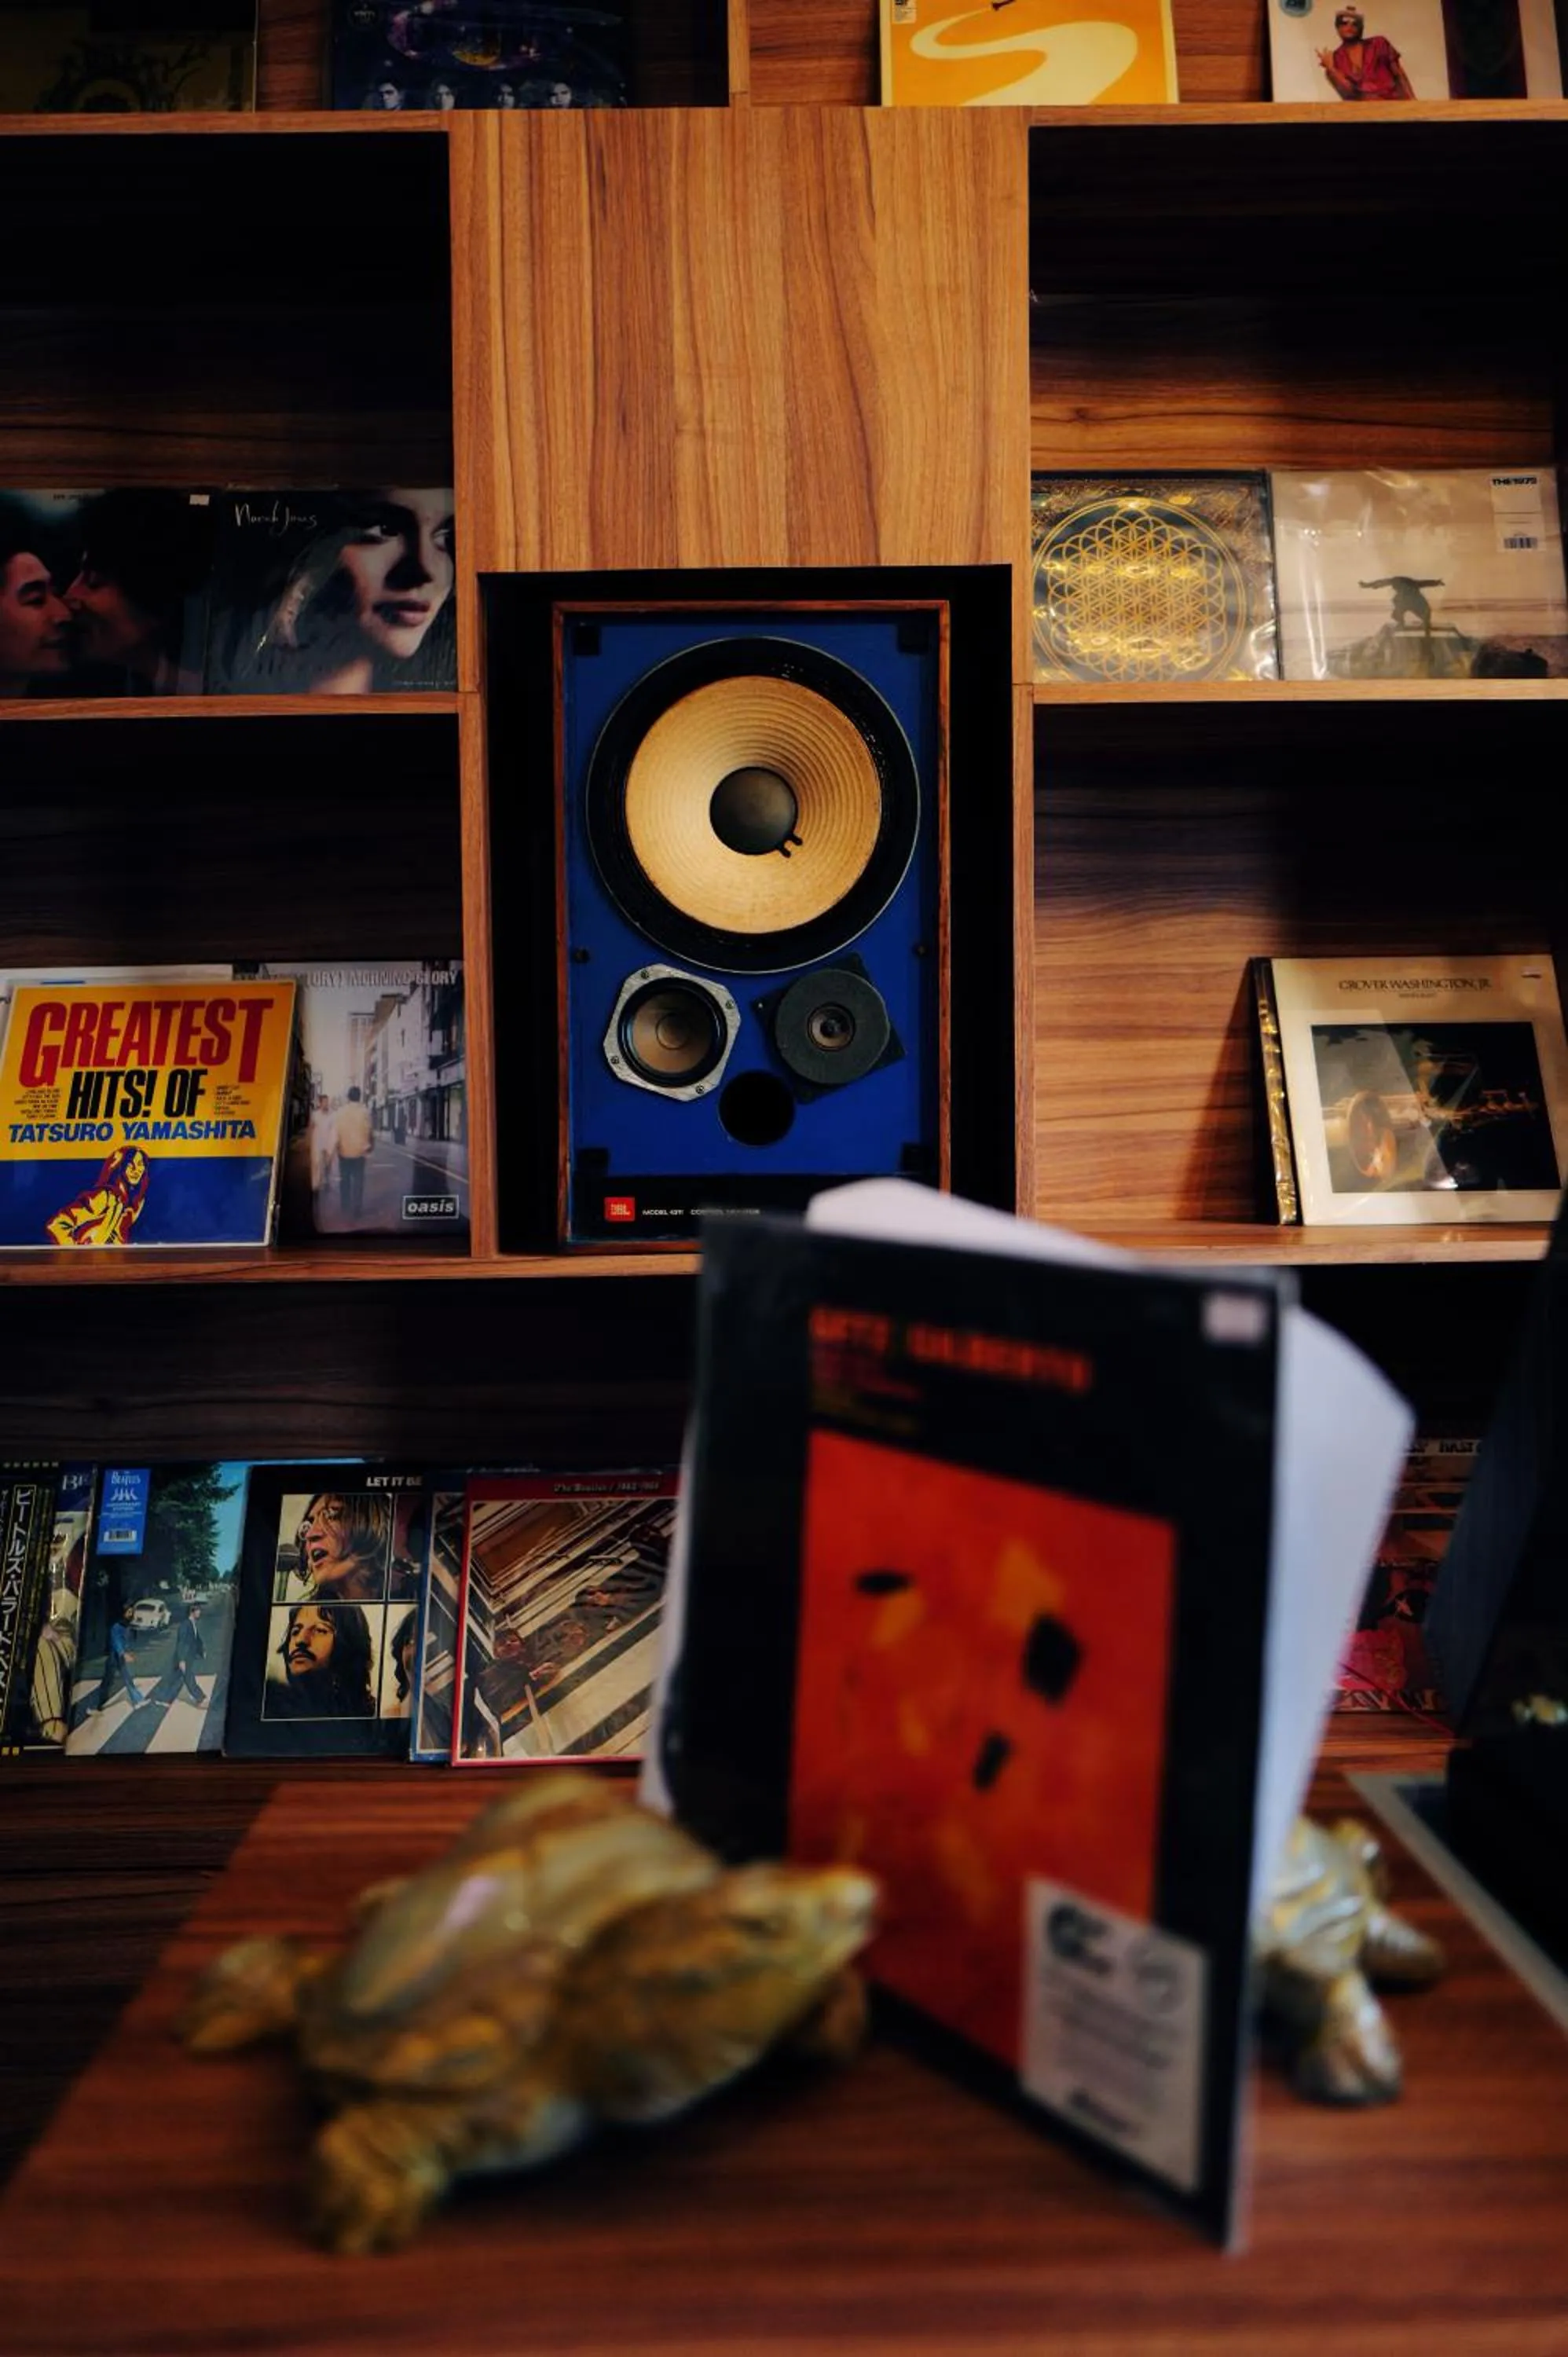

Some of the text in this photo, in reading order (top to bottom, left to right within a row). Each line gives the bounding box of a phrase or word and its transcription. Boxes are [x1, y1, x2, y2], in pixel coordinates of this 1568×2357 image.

[415, 969, 458, 987] GLORY
[1339, 979, 1388, 991] GROVER
[18, 998, 274, 1088] GREATEST
[66, 1069, 159, 1120] HITS!
[163, 1068, 208, 1118] OF
[9, 1119, 257, 1143] TATSURO YAMASHITA
[408, 1199, 455, 1213] oasis
[610, 1203, 631, 1216] JBL
[366, 1475, 423, 1487] LET IT BE
